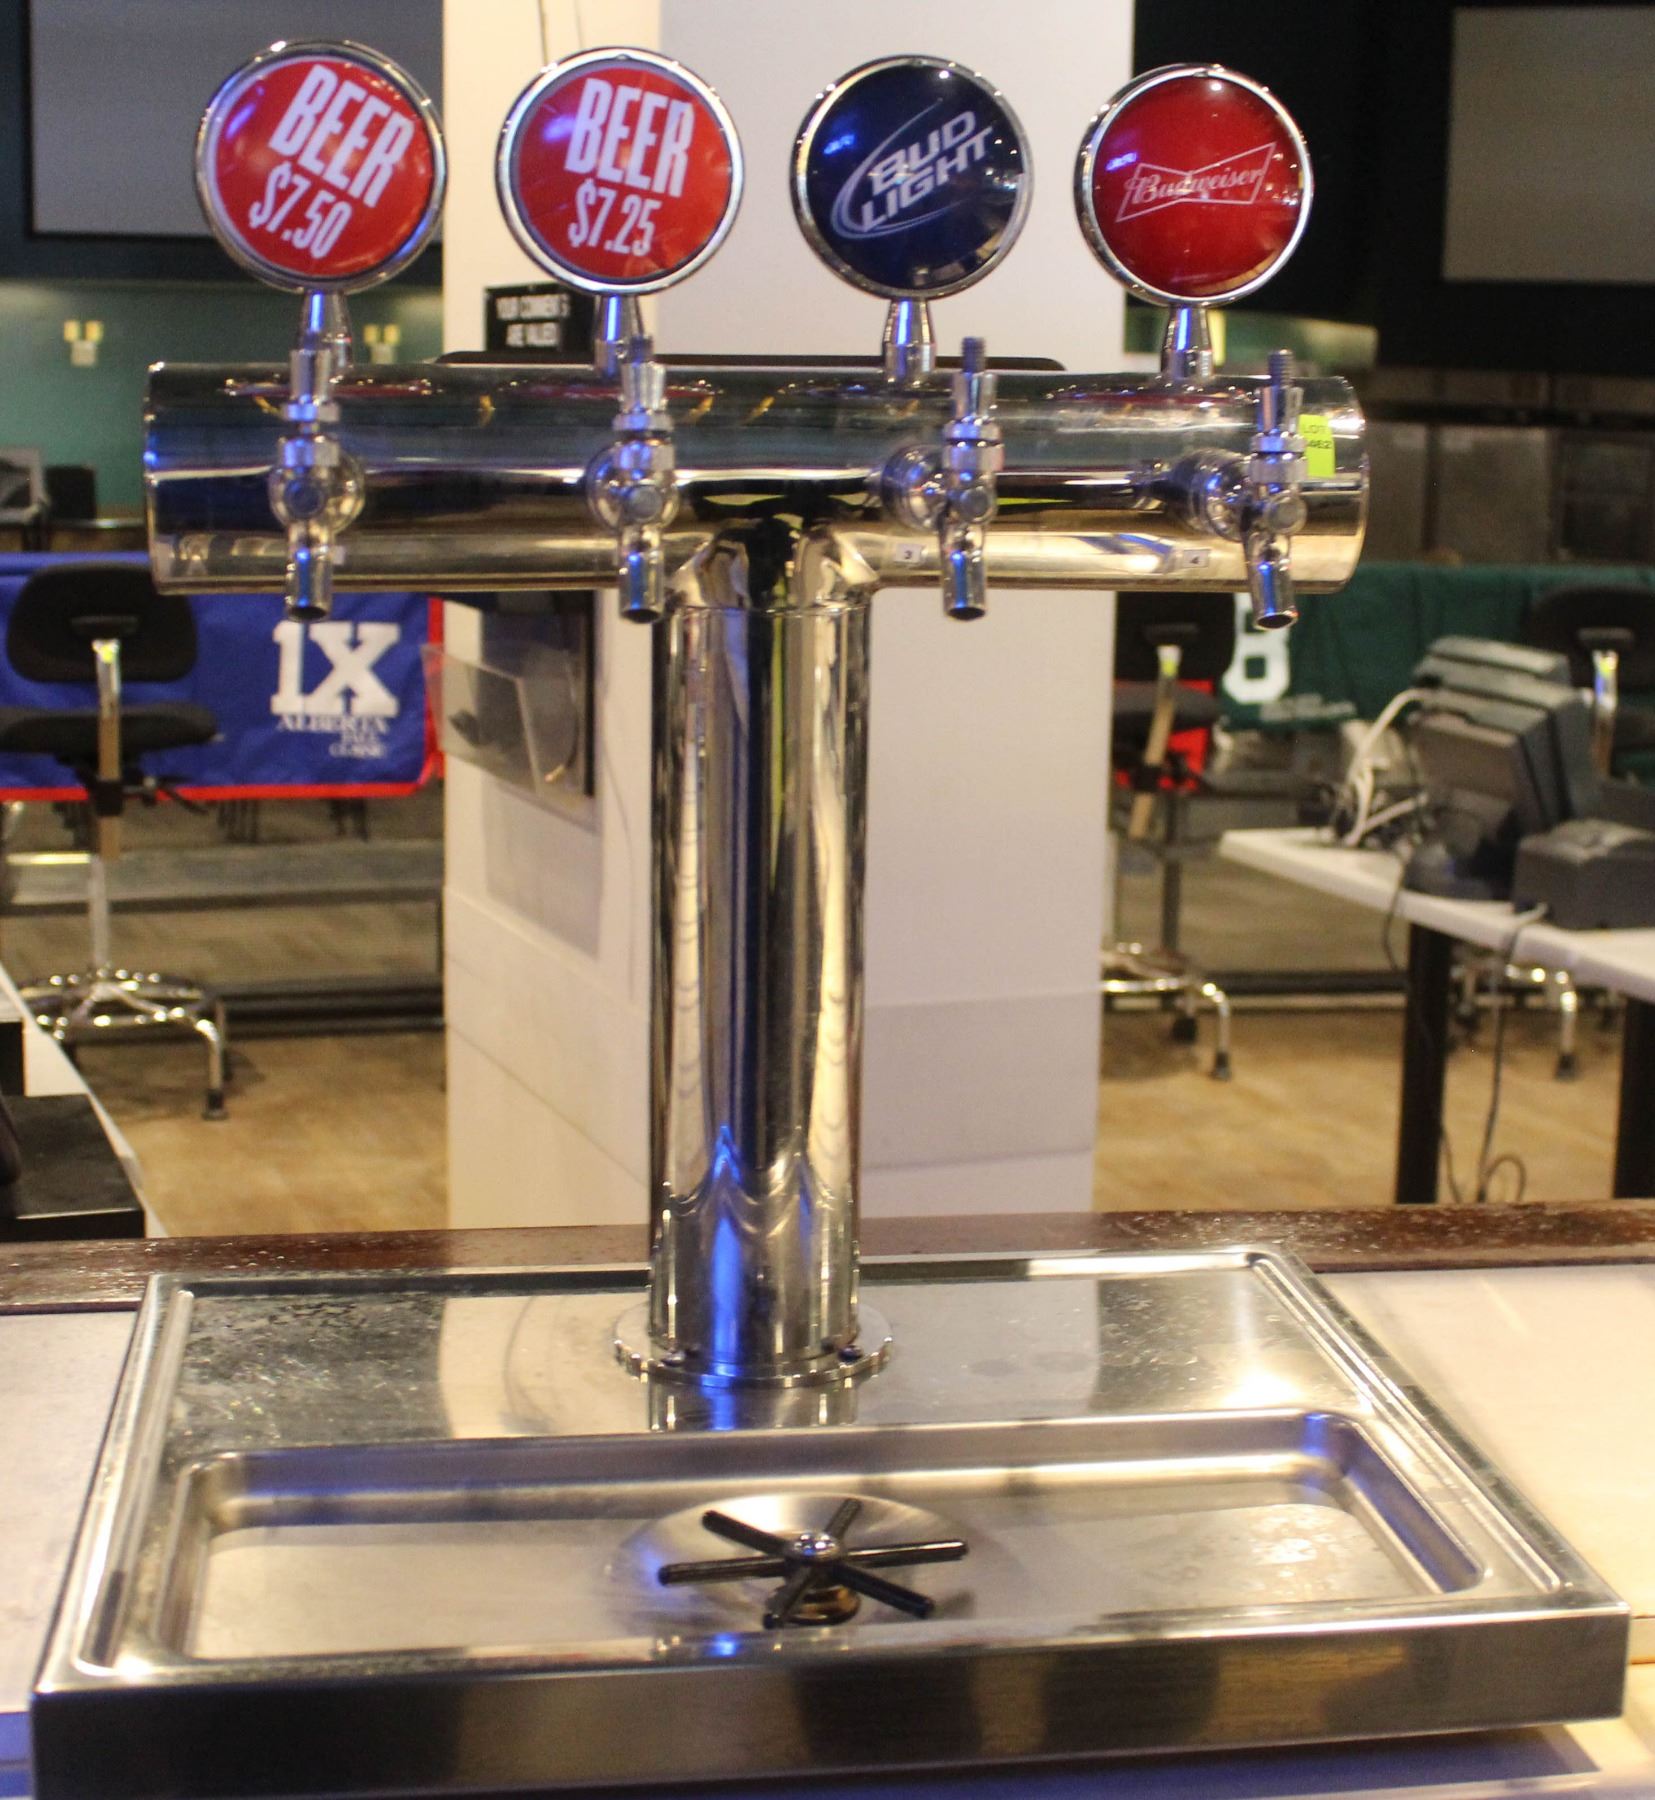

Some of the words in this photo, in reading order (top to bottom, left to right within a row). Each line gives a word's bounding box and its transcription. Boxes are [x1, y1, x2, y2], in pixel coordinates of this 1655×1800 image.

[268, 64, 416, 208] BEER
[564, 78, 695, 198] BEER
[861, 126, 993, 232] LIGHT
[871, 110, 977, 197] BUD
[249, 160, 353, 259] $7.50
[568, 178, 663, 257] $7.25
[1123, 168, 1266, 204] Budweiser
[1302, 423, 1330, 434] LOT
